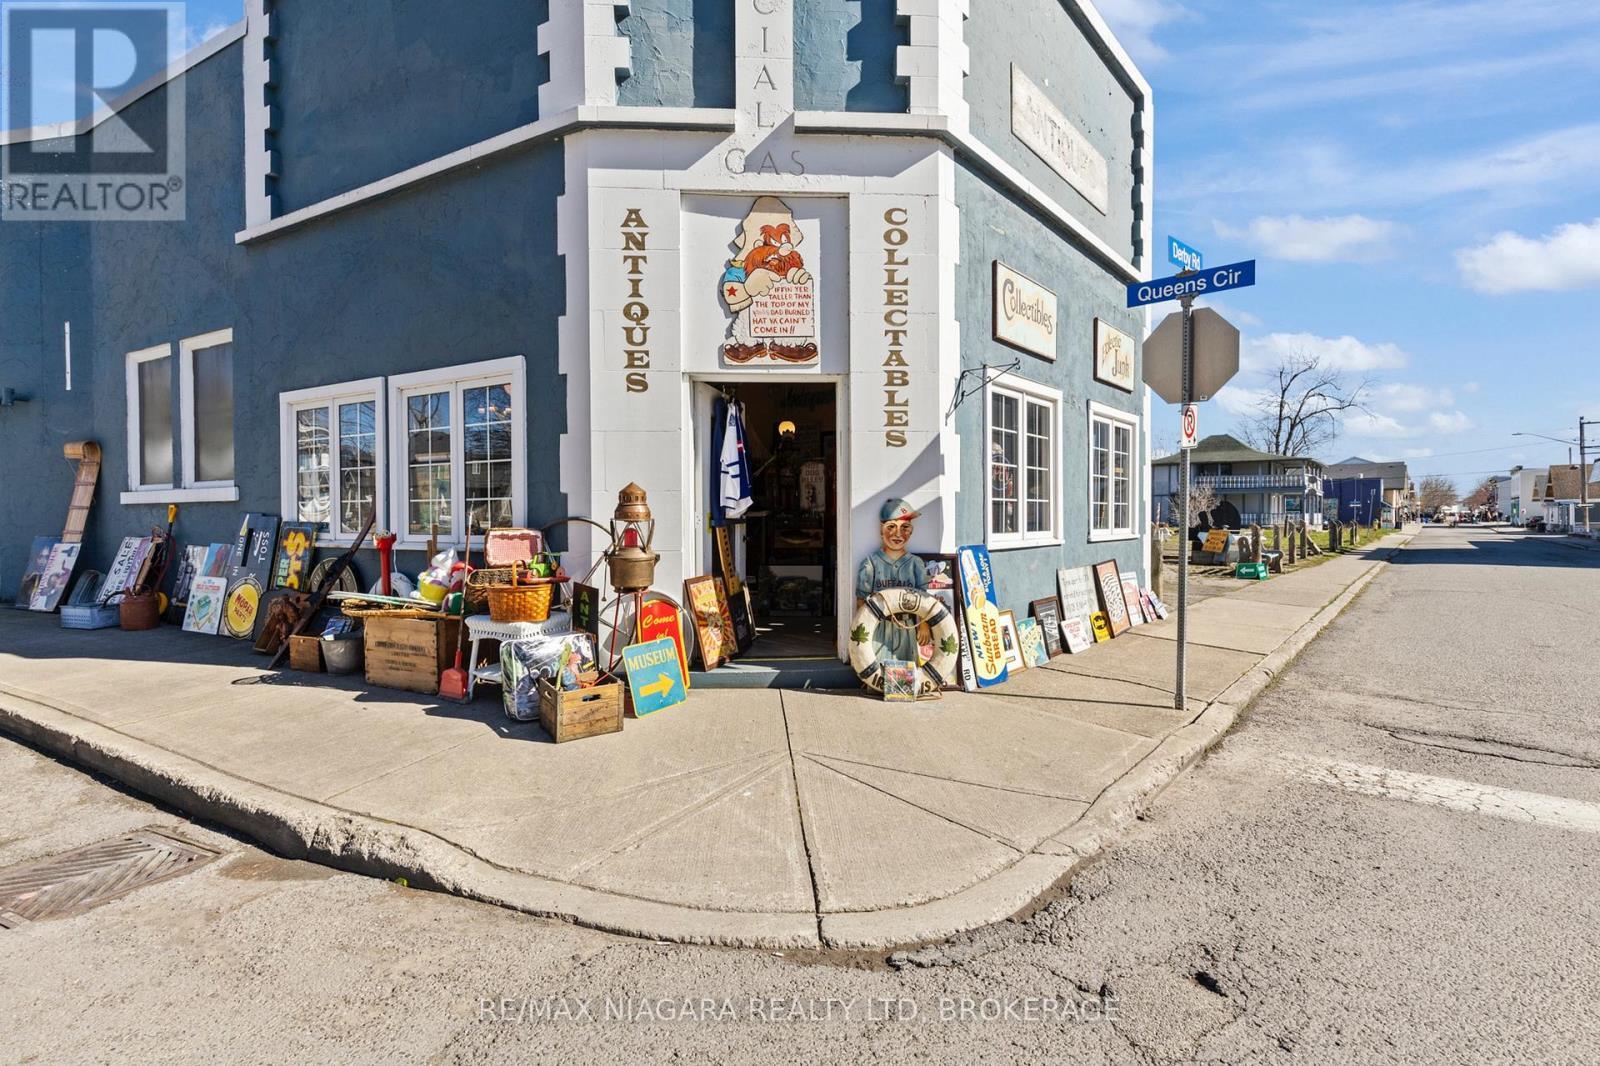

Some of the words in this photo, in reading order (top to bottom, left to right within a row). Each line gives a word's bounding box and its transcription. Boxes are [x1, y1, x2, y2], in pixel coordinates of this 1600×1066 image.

[724, 147, 805, 176] GAS
[1172, 241, 1192, 269] Derby
[1191, 252, 1201, 271] Rd
[620, 208, 651, 393] ANTIQUES
[1138, 277, 1207, 302] Queens
[1213, 269, 1242, 287] Cir
[1002, 278, 1053, 335] Collectibles
[882, 207, 910, 448] COLLECTABLES
[1112, 349, 1131, 378] Junk
[114, 541, 133, 575] SALE
[258, 531, 271, 564] TOSS
[276, 558, 290, 586] PER
[234, 593, 255, 617] MOPAR
[642, 614, 676, 629] Come
[980, 612, 998, 676] Sunbeam
[989, 618, 1001, 660] BREAD
[627, 647, 676, 671] MUSEUM
[963, 669, 971, 681] RD
